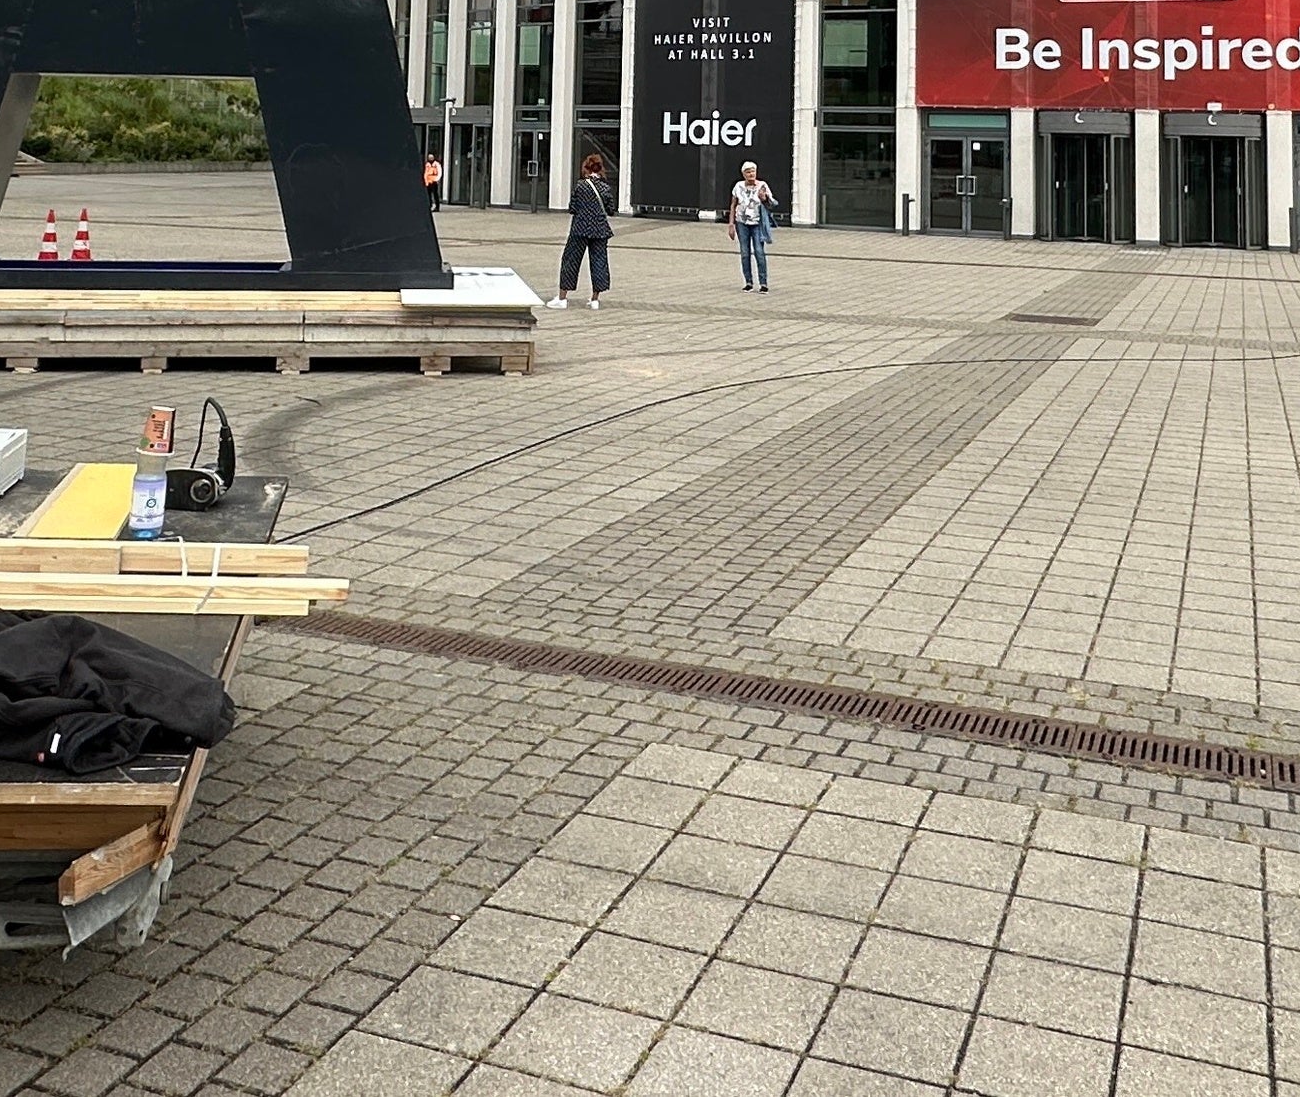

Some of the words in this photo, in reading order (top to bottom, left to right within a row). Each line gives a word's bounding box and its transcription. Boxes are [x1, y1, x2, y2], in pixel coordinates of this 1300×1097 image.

[692, 16, 730, 28] VISIT
[654, 33, 694, 45] HAIER
[701, 32, 772, 44] PAVILLON
[667, 49, 684, 60] AT
[690, 48, 725, 60] HALL
[732, 48, 755, 60] 3.1
[995, 28, 1062, 70] Be
[663, 110, 757, 146] Haier
